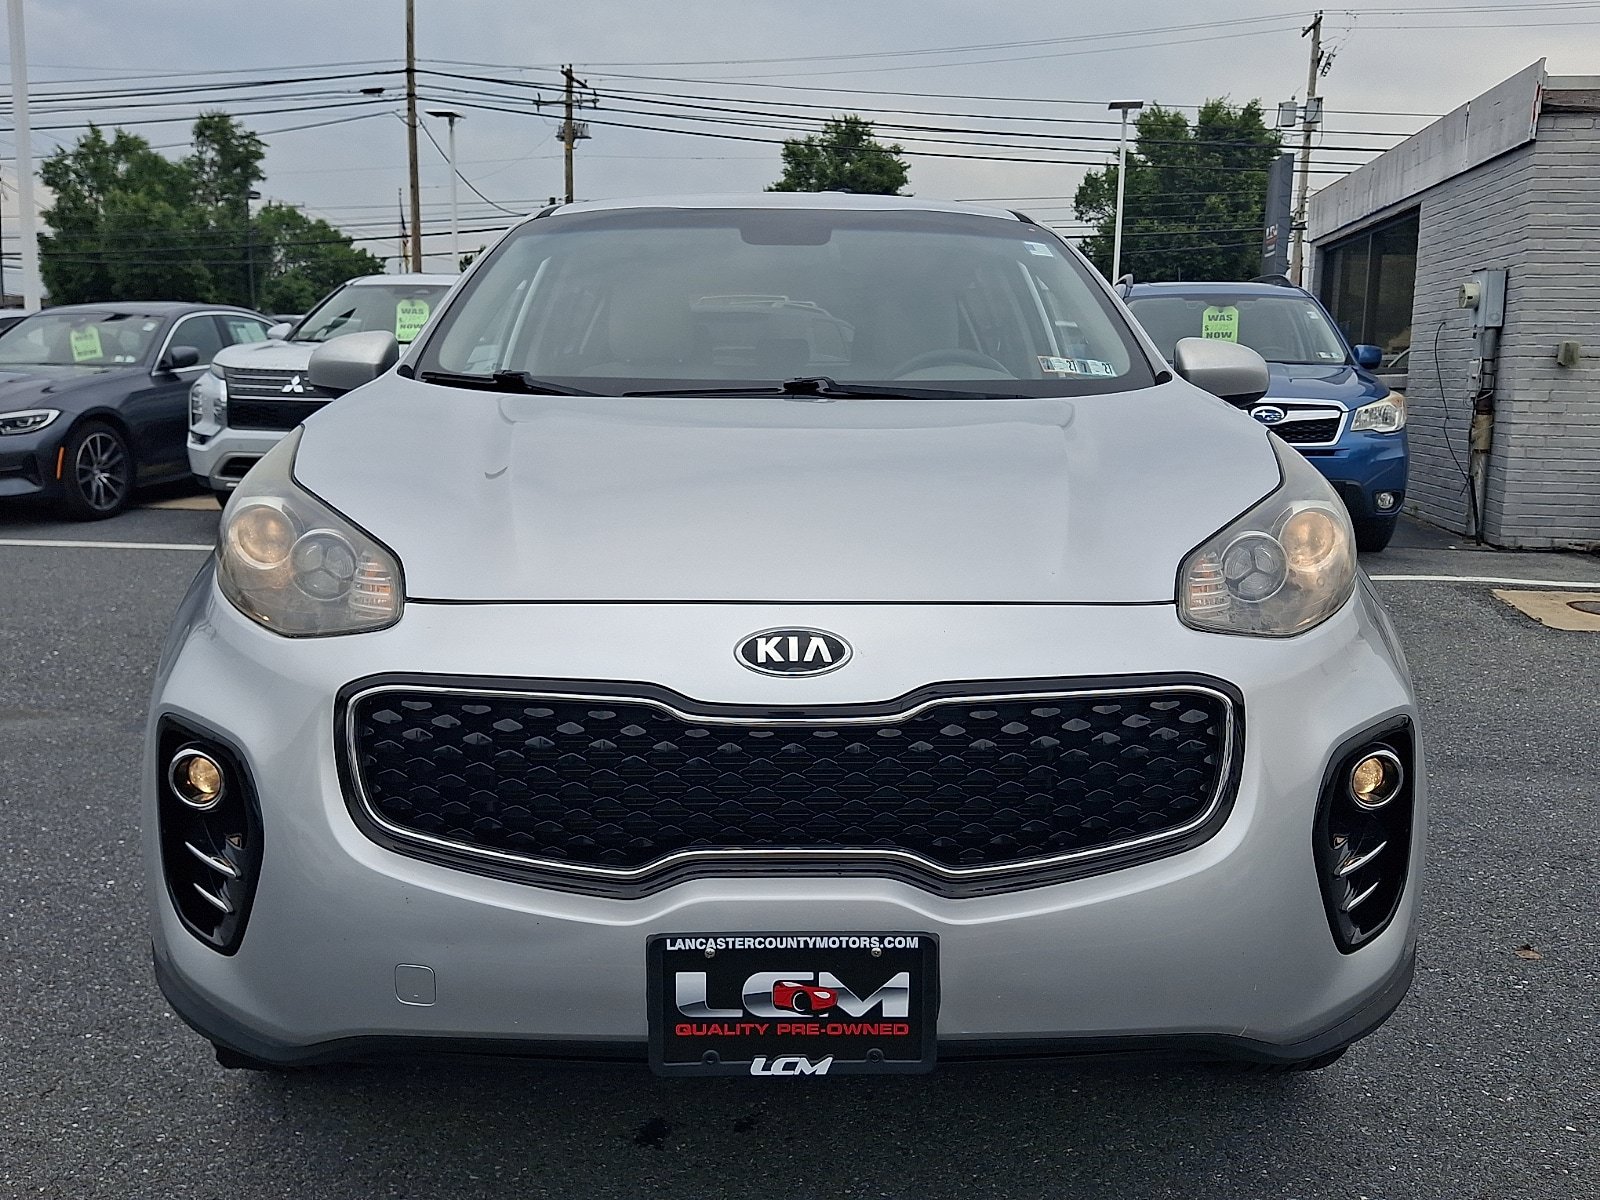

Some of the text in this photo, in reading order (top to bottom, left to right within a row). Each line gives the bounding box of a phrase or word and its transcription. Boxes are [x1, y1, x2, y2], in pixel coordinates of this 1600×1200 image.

[1208, 314, 1233, 322] WAS
[1206, 331, 1233, 339] NOW
[755, 636, 833, 663] KIA
[666, 937, 919, 950] LANCASTERCOUNTYMOTORS.COM
[675, 971, 910, 1018] LCM
[675, 1023, 909, 1036] QUALITY PRE-OWNED
[750, 1056, 834, 1076] LCM
